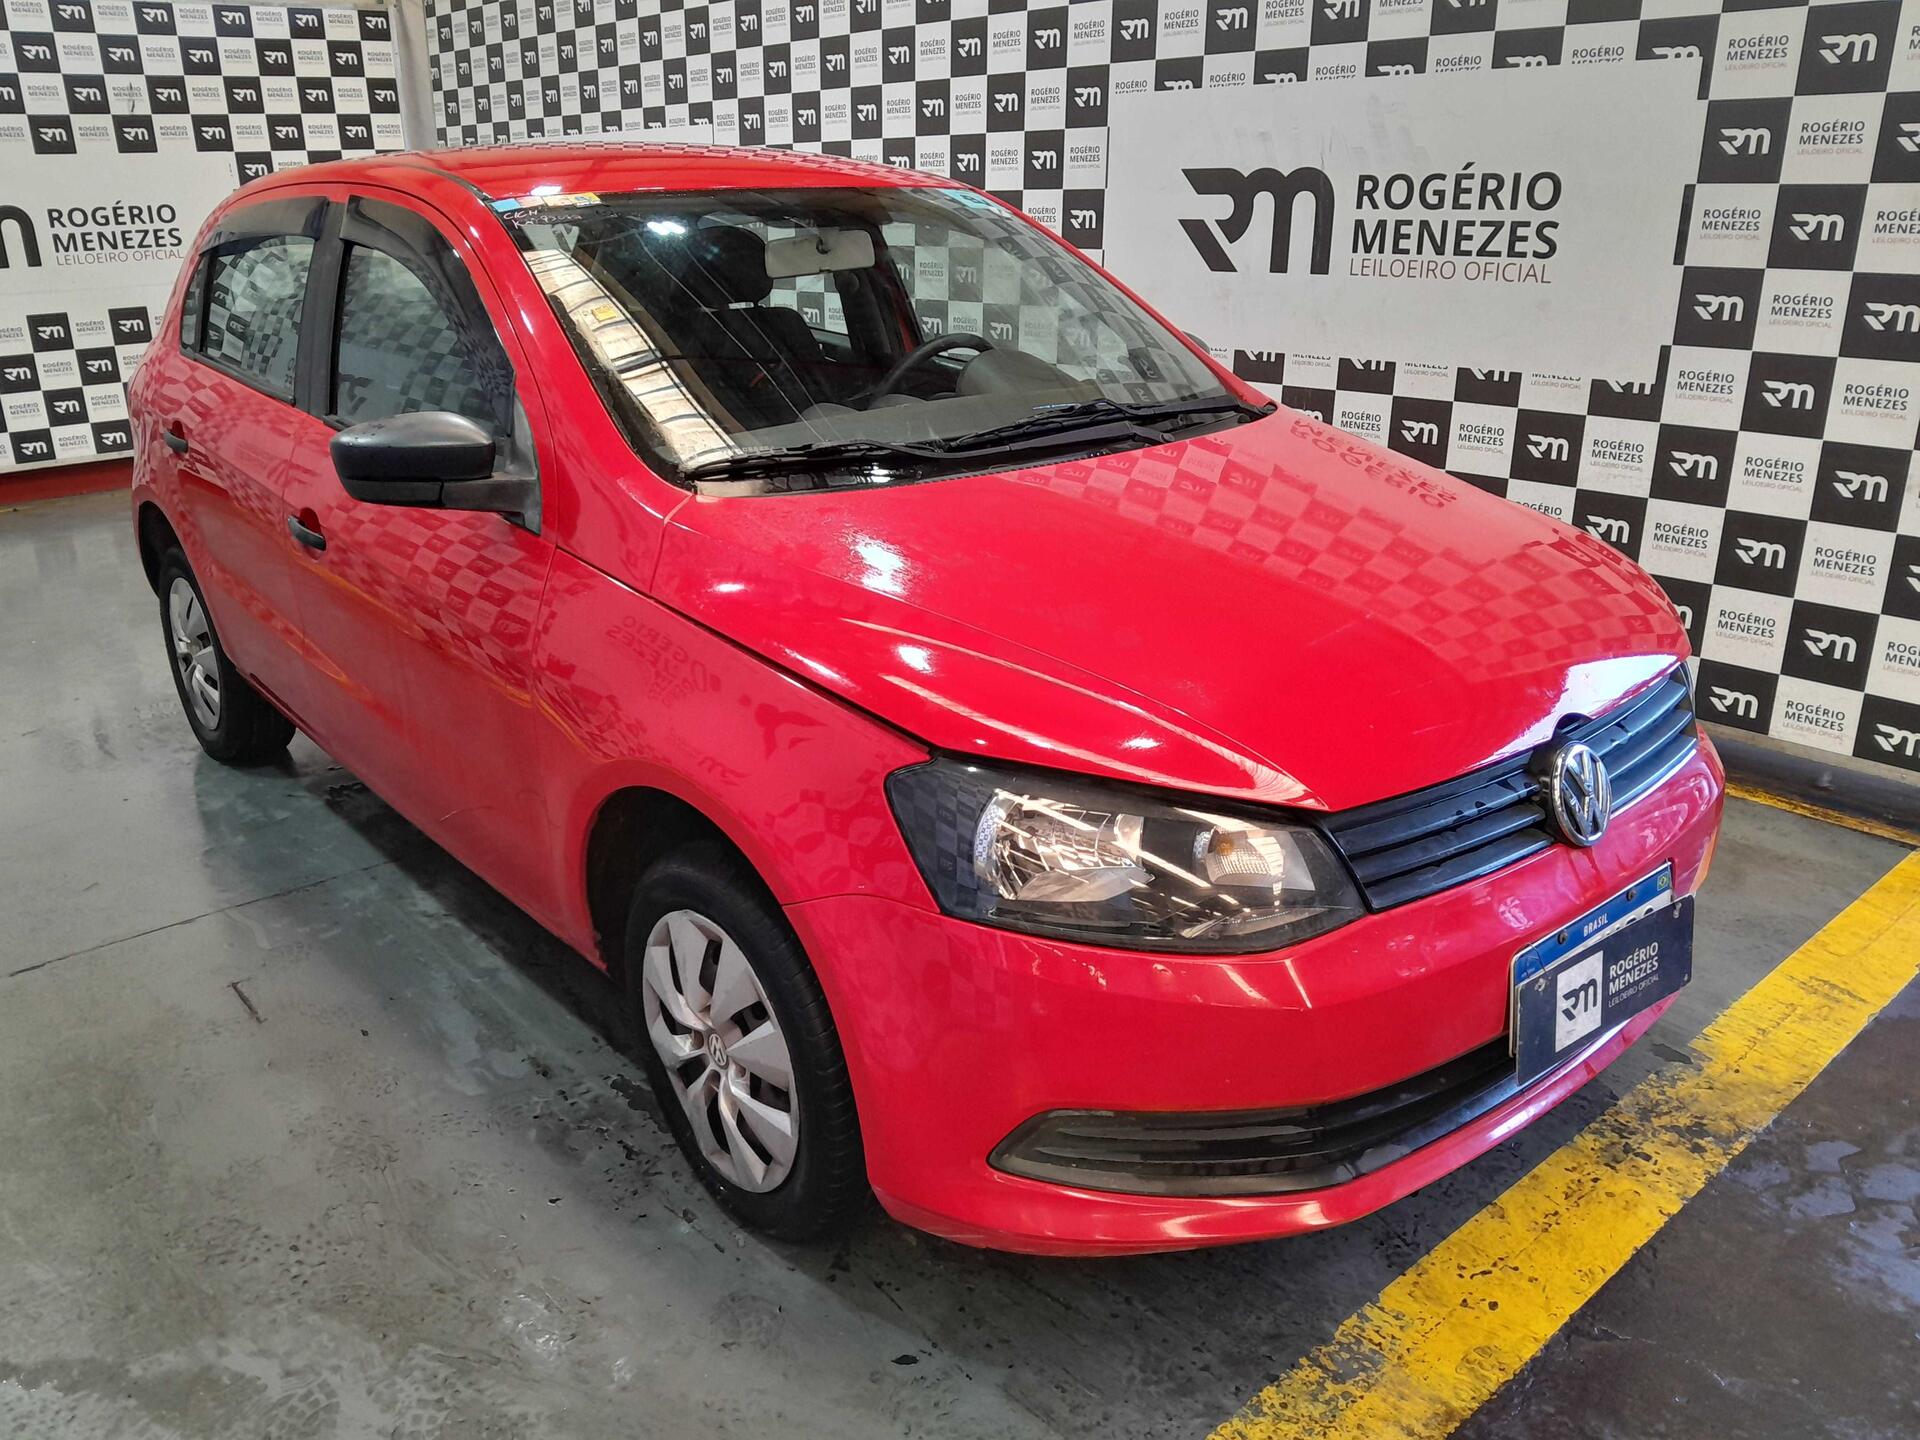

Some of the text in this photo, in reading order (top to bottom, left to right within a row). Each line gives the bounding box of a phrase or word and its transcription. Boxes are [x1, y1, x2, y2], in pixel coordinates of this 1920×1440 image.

[1165, 10, 1198, 20] ROGÉRIO
[1266, 8, 1304, 18] MENEZES
[1074, 20, 1104, 30] ROGÉRIO
[1164, 19, 1198, 29] MENEZES
[993, 30, 1020, 39] ROGÉRIO
[1074, 29, 1104, 38] MENEZES
[993, 39, 1020, 47] MENEZES
[1729, 34, 1788, 49] ROGÉRIO
[1573, 47, 1624, 62] ROGÉRIO
[1727, 48, 1787, 60] MENEZES
[1435, 54, 1482, 67] ROGÉRIO
[1316, 65, 1356, 76] ROGÉRIO
[1210, 72, 1245, 83] ROGÉRIO
[1031, 87, 1060, 95] ROGÉRIO
[1116, 80, 1147, 90] ROGÉRIO
[955, 92, 981, 102] ROGÉRIO
[1031, 96, 1060, 104] MENEZES
[887, 106, 910, 114] MENEZES
[955, 101, 981, 110] MENEZES
[1802, 121, 1864, 132] ROGÉRIO
[1800, 134, 1863, 144] MENEZES
[920, 151, 945, 160] ROGÉRIO
[991, 149, 1018, 157] ROGÉRIO
[1070, 146, 1100, 154] ROGÉRIO
[991, 156, 1019, 166] MENEZES
[1070, 154, 1100, 162] MENEZES
[1356, 162, 1561, 210] ROGÉRIO
[48, 200, 175, 228] ROGÉRIO
[1028, 206, 1057, 215] ROGÉRIO
[1704, 207, 1760, 219] ROGÉRIO
[1702, 221, 1760, 231] MENEZES
[52, 228, 182, 253] MENEZES
[1352, 219, 1559, 259] MENEZES
[56, 248, 184, 266] LEILOEIRO OFICIAL
[1350, 257, 1552, 285] LEILOEIRO OFICIAL
[1773, 294, 1833, 306] ROGÉRIO
[1771, 306, 1832, 318] MENEZES
[1679, 370, 1734, 383] ROGÉRIO
[1677, 381, 1732, 394] MENEZES
[1846, 384, 1908, 398] ROGÉRIO
[1843, 396, 1907, 410] MENEZES
[1342, 411, 1381, 422] ROGÉRIO
[1341, 420, 1380, 432] MENEZES
[1460, 424, 1504, 436] ROGÉRIO
[1458, 434, 1503, 446] MENEZES
[1594, 439, 1644, 452] ROGÉRIO
[1592, 449, 1642, 463] MENEZES
[1746, 457, 1804, 472] ROGÉRIO
[1744, 468, 1802, 483] MENEZES
[1654, 523, 1708, 541] ROGÉRIO
[1654, 530, 1708, 549] MENEZES
[1814, 547, 1876, 567] ROGÉRIO
[1814, 555, 1876, 576] MENEZES
[1718, 610, 1775, 631] ROGÉRIO
[1718, 616, 1775, 638] MENEZES
[1785, 700, 1845, 722] ROGÉRIO
[1785, 708, 1845, 731] MENEZES
[1584, 913, 1608, 937] BRASIL
[1609, 942, 1659, 979] ROGÉRIO
[1609, 956, 1659, 995] MENEZES
[1608, 975, 1659, 1008] LEILOEIRO OFICIAL
